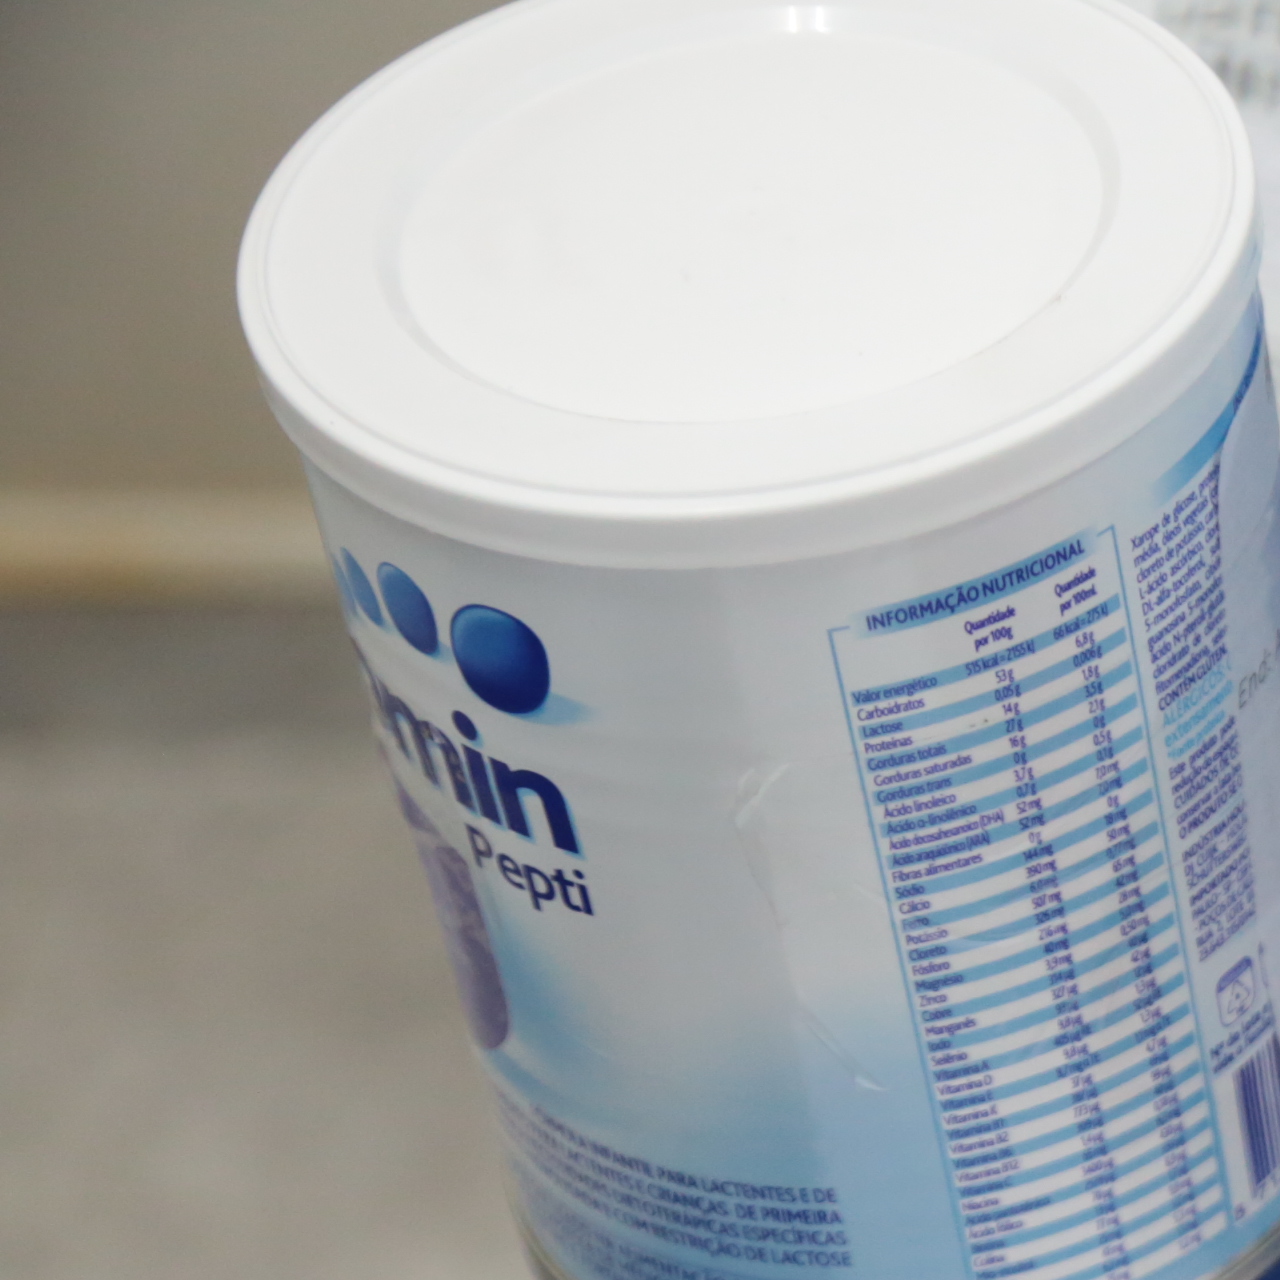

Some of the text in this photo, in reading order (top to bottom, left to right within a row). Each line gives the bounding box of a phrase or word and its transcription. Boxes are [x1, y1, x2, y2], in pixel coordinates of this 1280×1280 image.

[865, 538, 1086, 632] INFORMAÇÃO NUTRICIONAL
[1053, 566, 1097, 598] Quantidade
[963, 605, 1016, 635] Quantidade
[1059, 597, 1073, 617] por
[974, 625, 1014, 652] por 100g
[852, 675, 939, 705] Valor energético
[857, 699, 926, 723] Carboidratos
[862, 720, 904, 738] Lactose
[867, 744, 948, 772] Gorduras totais
[873, 754, 973, 787] Gorduras saturadas
[876, 777, 952, 804] Gorduras trans
[465, 822, 594, 916] Pepti
[700, 1177, 838, 1205] LACTENTES DE
[770, 1247, 854, 1268] LACTOSE
